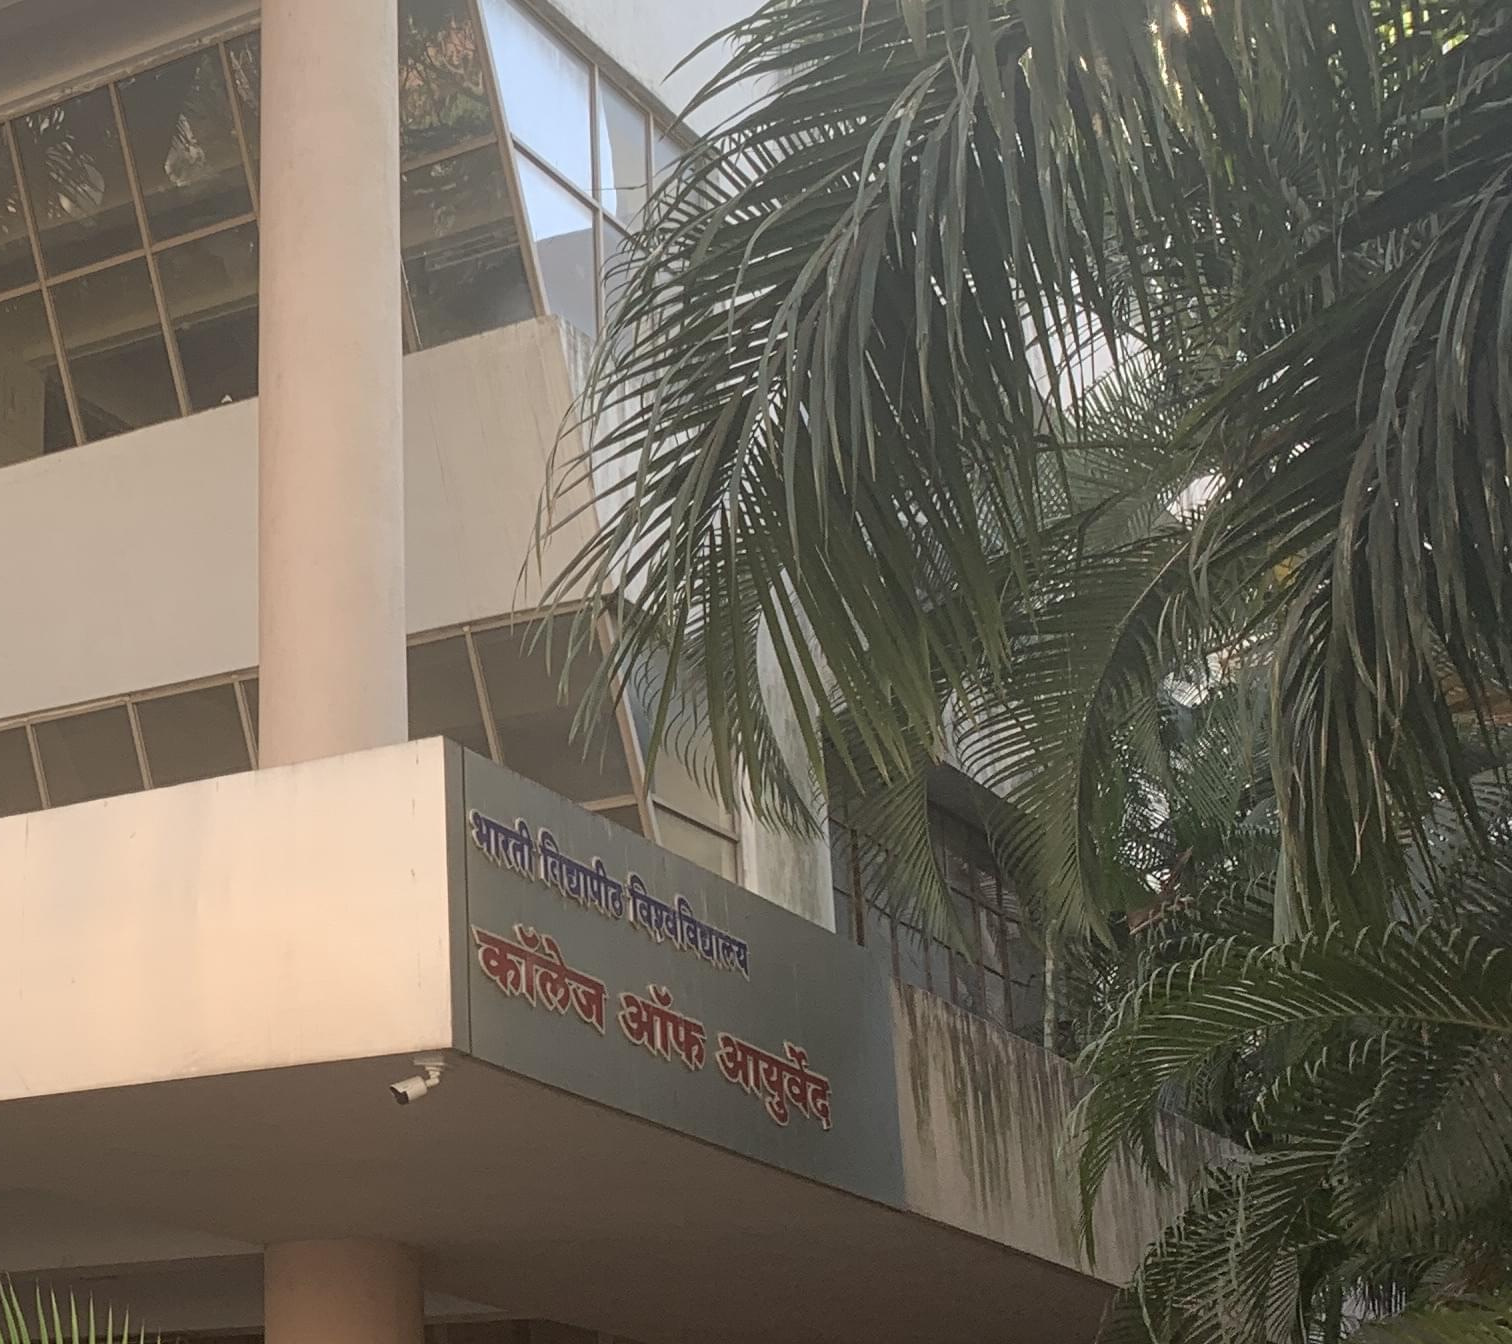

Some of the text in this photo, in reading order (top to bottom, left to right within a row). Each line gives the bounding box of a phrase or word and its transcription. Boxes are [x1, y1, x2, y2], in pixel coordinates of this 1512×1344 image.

[469, 808, 751, 981] भारती विद्यापीठ विश्वविद्यालय
[471, 924, 833, 1130] कॉलेज ऑफ आयुर्वेद
